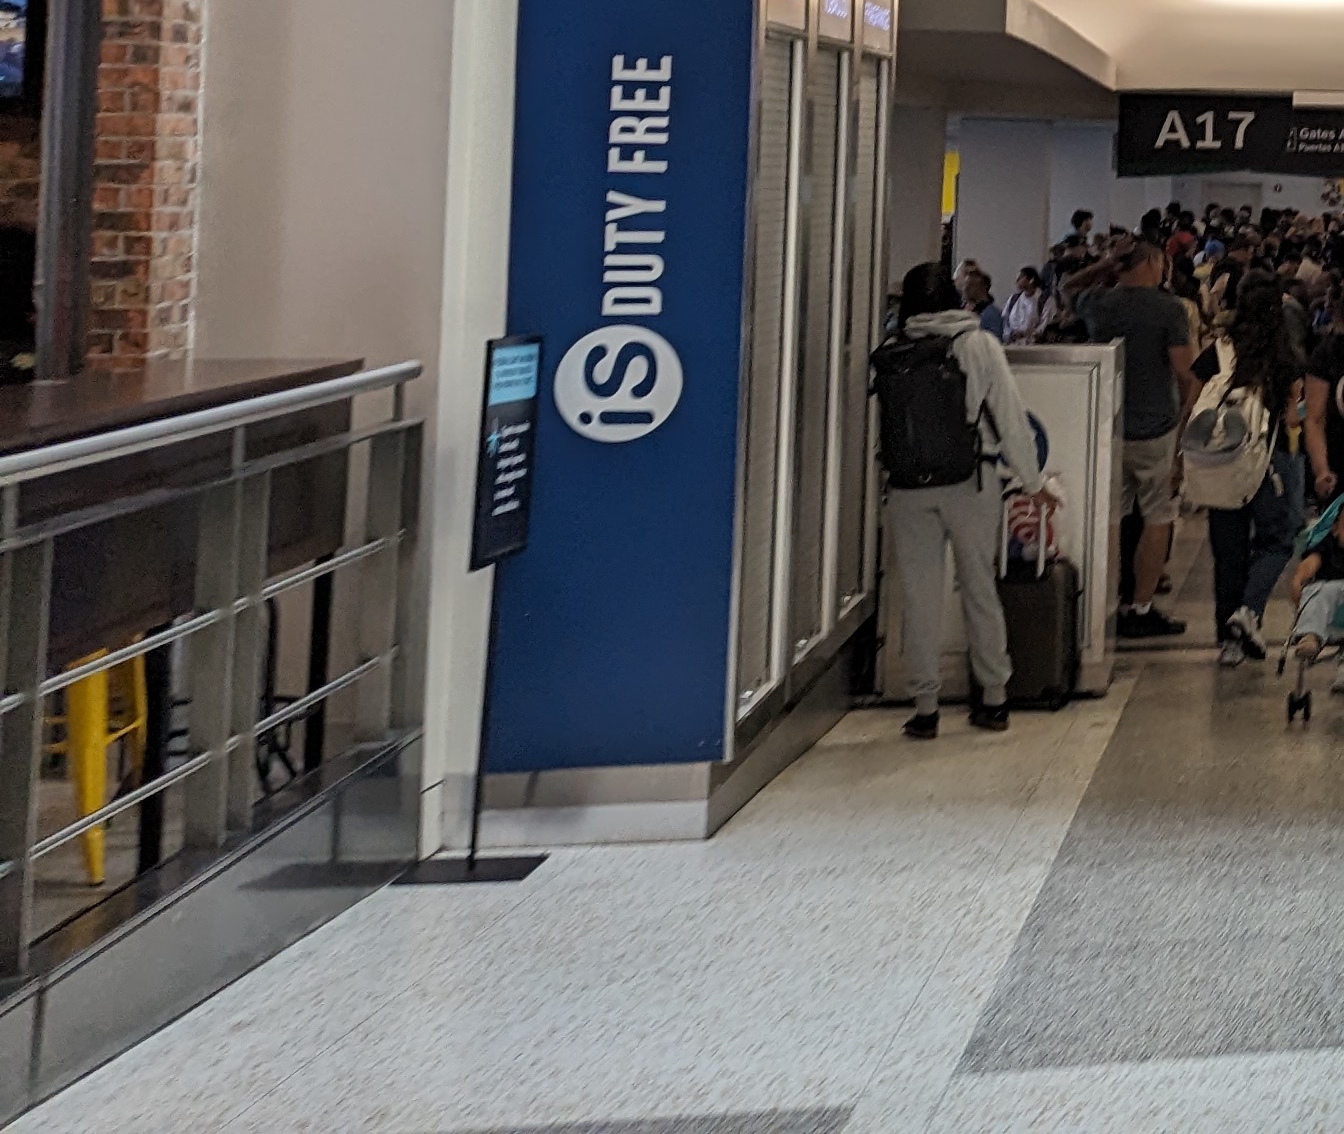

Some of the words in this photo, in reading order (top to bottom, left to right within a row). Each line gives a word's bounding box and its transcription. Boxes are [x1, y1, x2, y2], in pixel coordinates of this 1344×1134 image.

[608, 53, 674, 173] FREE
[1154, 110, 1256, 151] A17
[1299, 127, 1336, 141] Gates
[602, 188, 666, 318] DUTY
